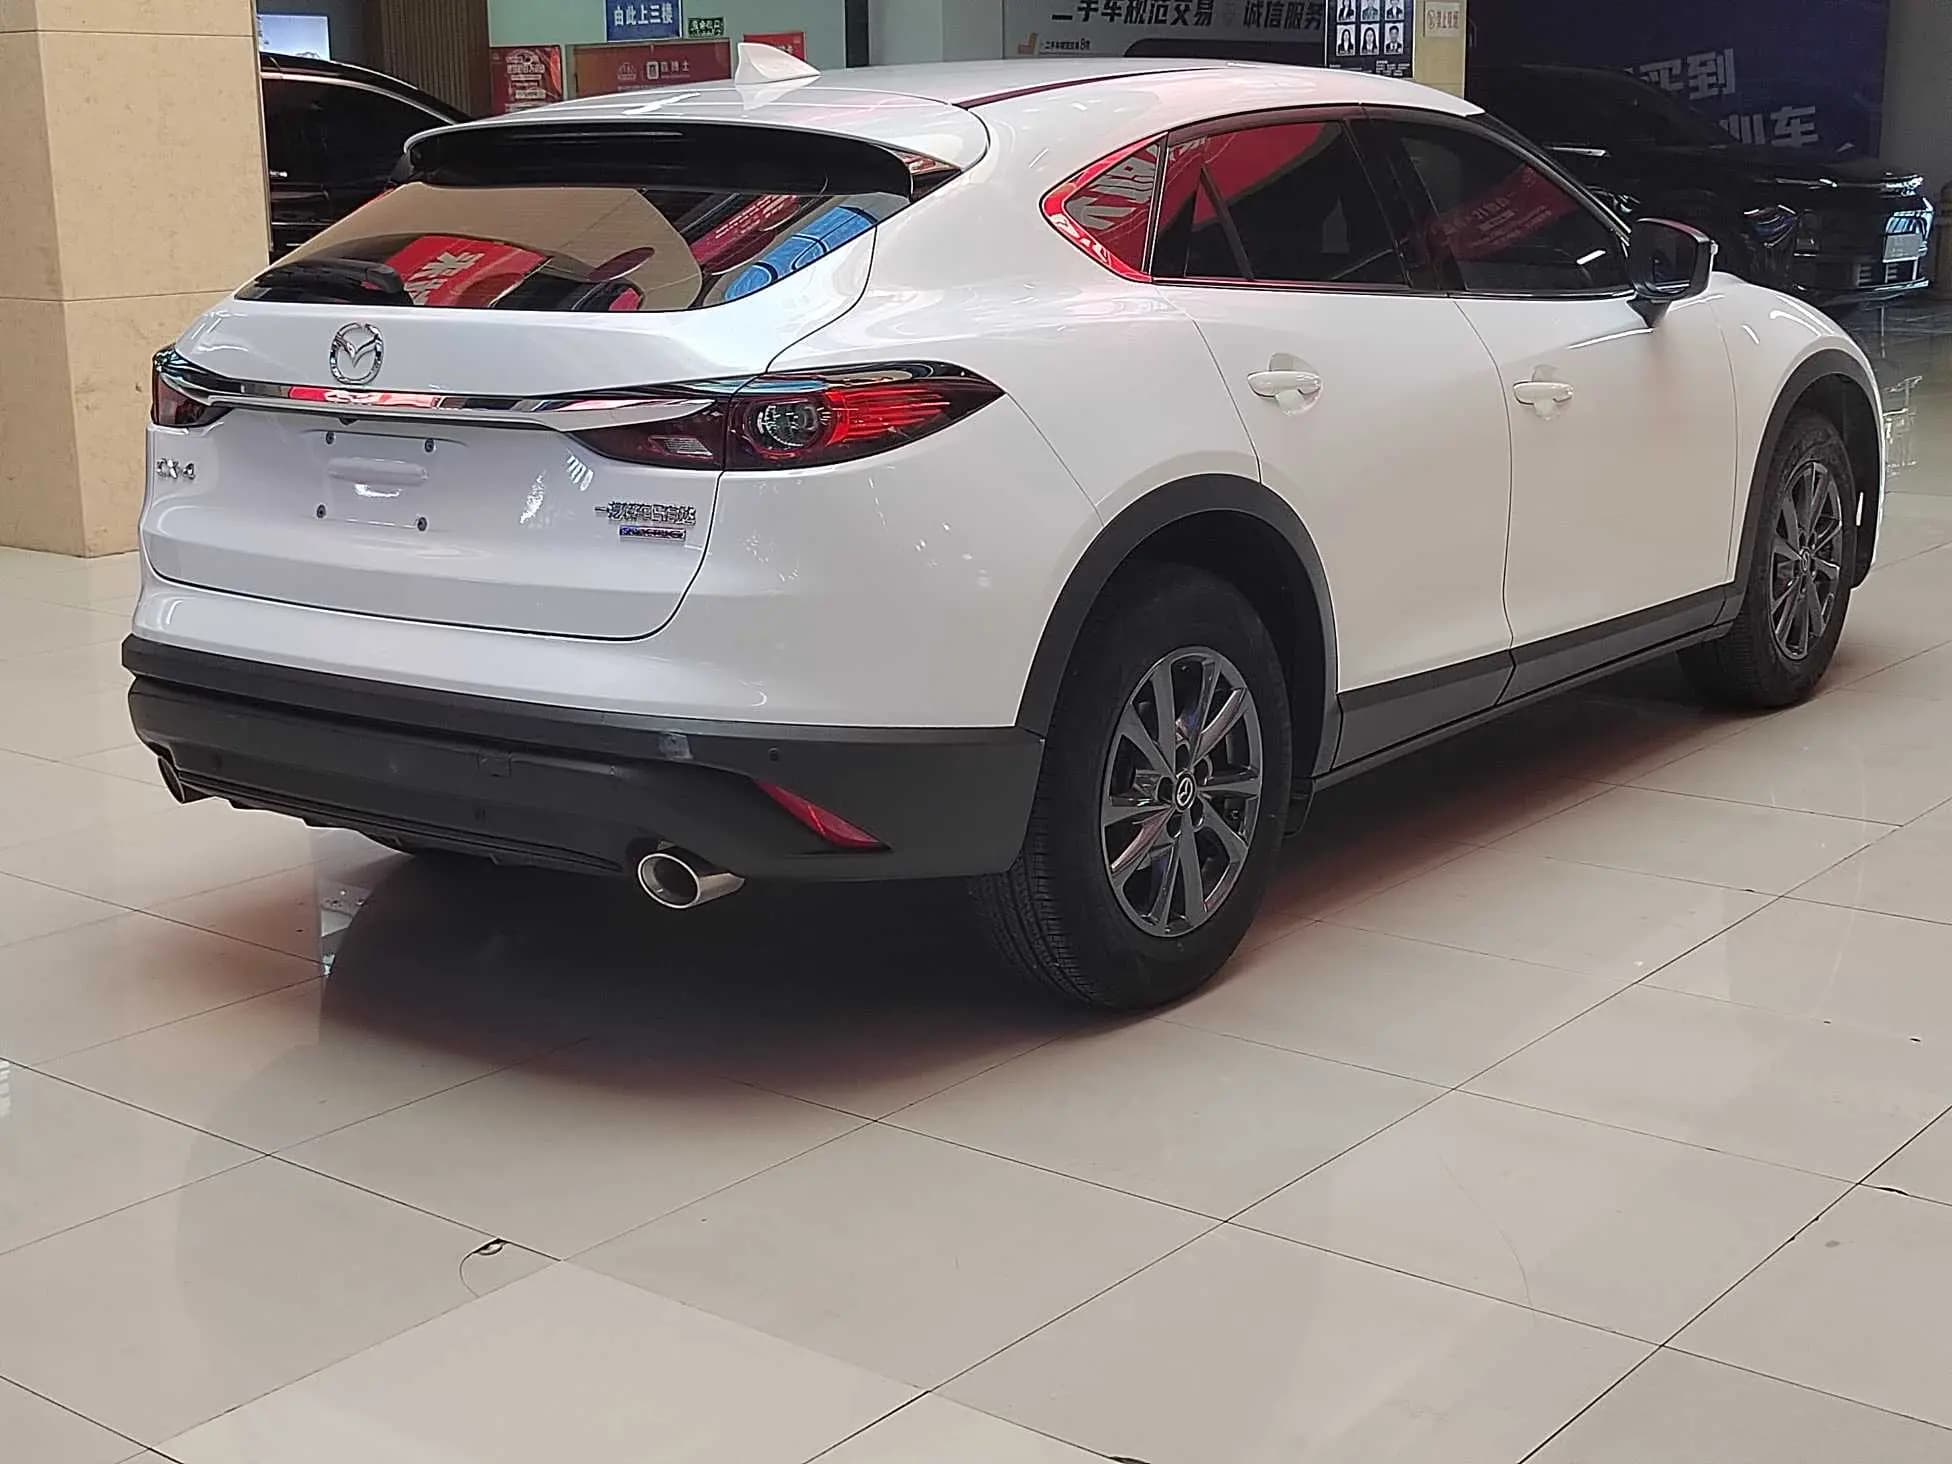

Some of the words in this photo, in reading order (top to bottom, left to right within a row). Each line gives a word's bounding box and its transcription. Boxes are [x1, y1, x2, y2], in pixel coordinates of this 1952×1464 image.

[613, 2, 673, 26] 由此上三楼
